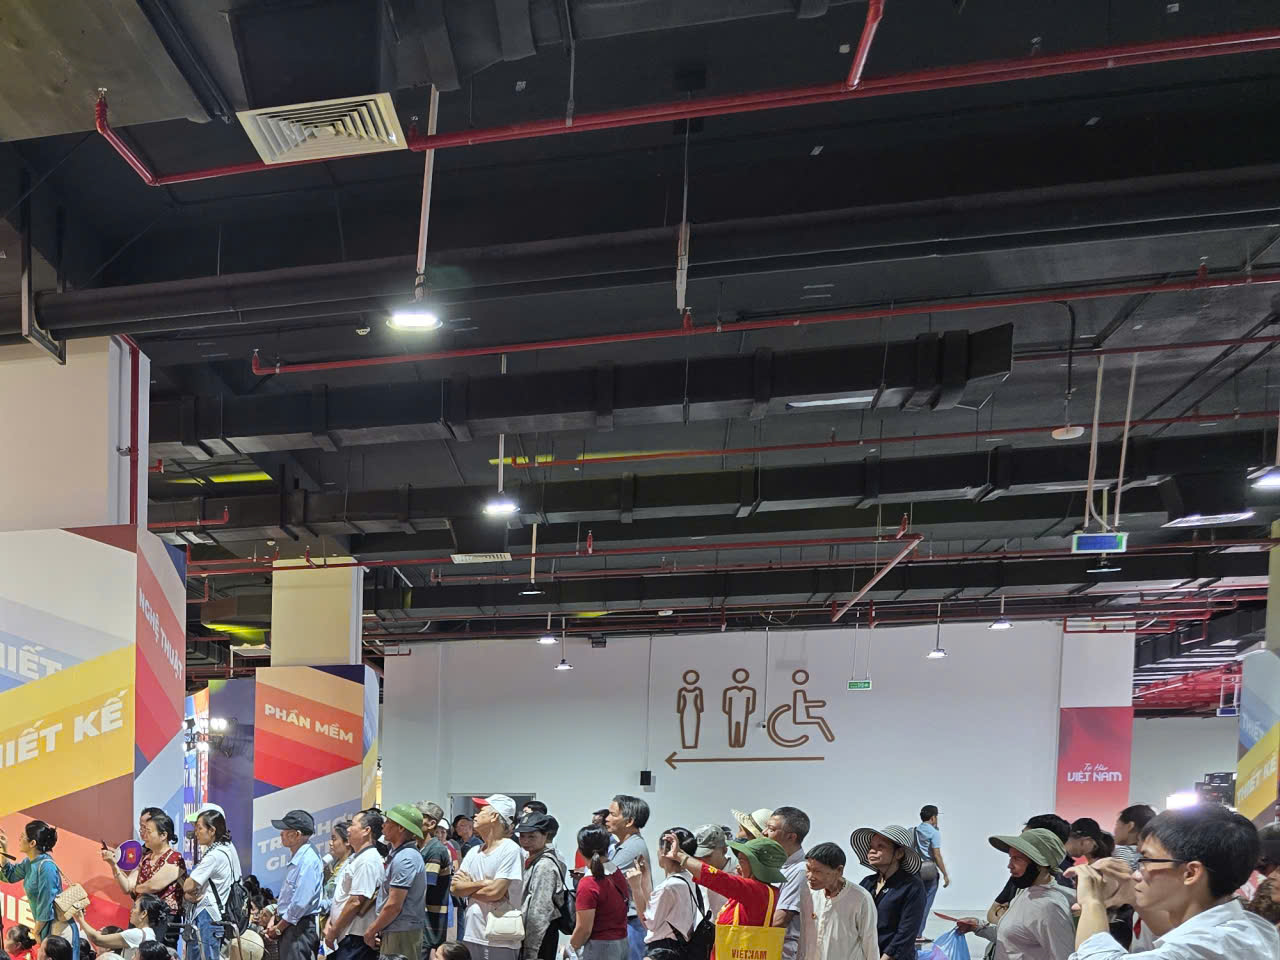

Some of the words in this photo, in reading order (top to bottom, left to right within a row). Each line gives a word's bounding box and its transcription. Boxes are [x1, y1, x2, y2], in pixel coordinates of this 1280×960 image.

[74, 689, 129, 744] KẾ
[263, 703, 311, 729] PHẦN
[315, 720, 354, 744] MỀM
